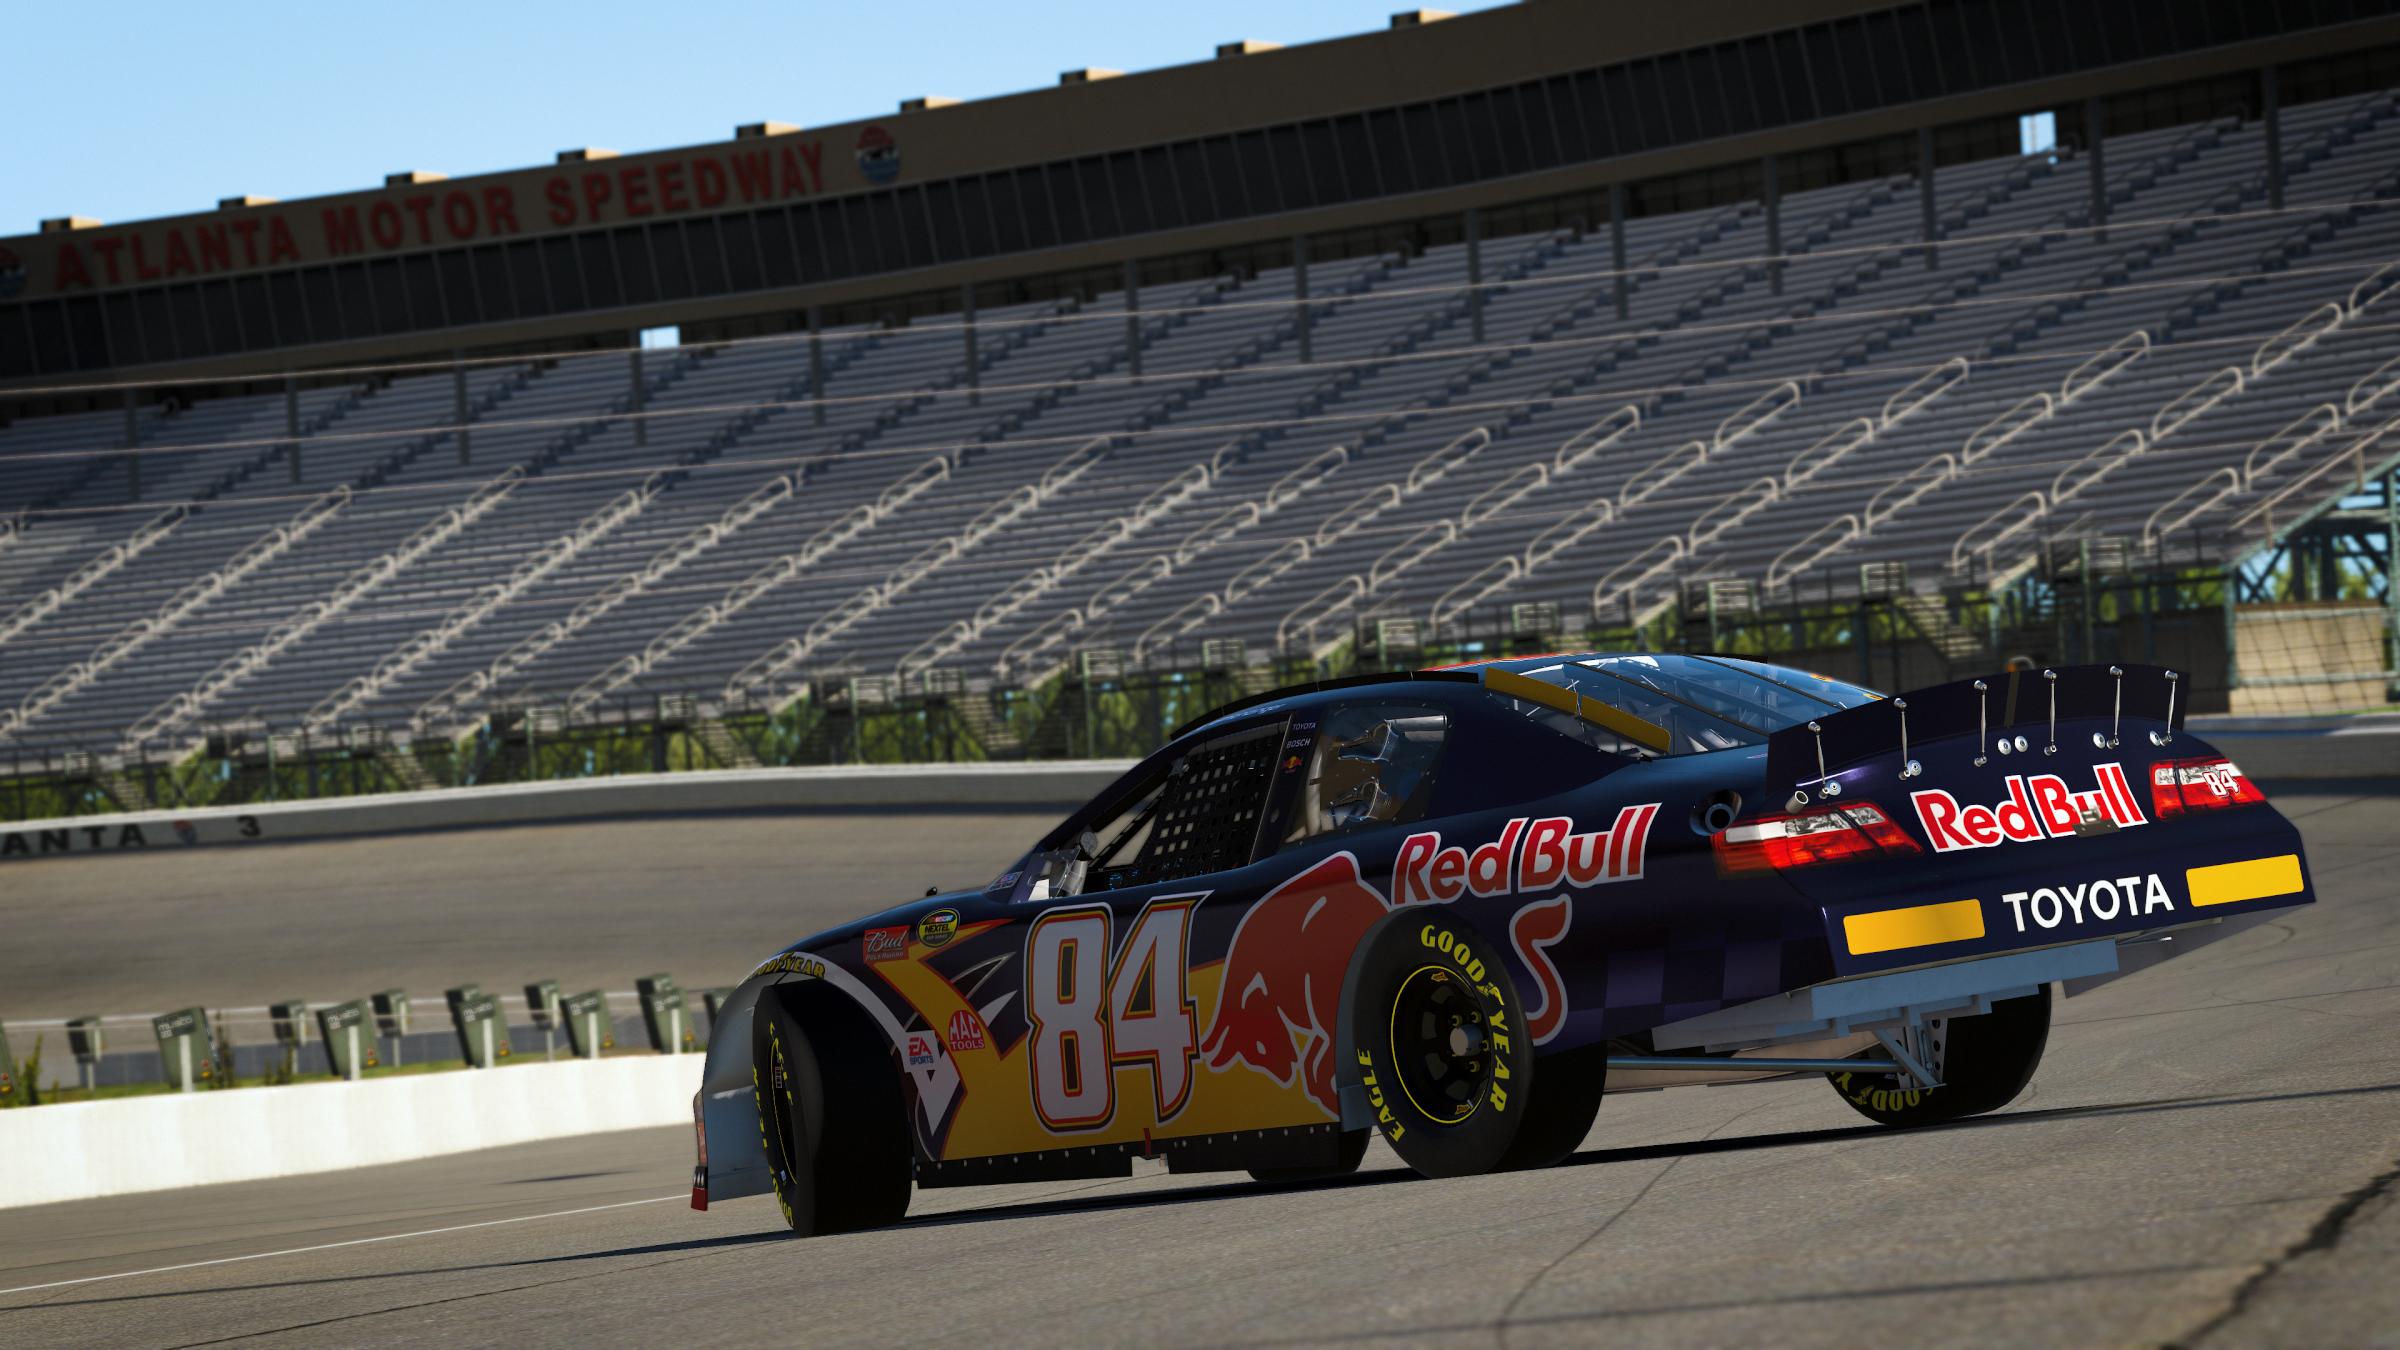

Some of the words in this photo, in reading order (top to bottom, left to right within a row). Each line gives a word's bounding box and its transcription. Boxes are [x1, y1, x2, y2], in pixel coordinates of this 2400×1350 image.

[55, 214, 301, 290] ATLANTA
[322, 186, 521, 257] MOTOR
[544, 141, 824, 226] SPEEDWAY
[1286, 737, 1312, 749] BOSCH
[1292, 721, 1317, 730] TOYOTA
[2202, 769, 2240, 798] 84
[1910, 774, 2046, 853] Red
[1, 823, 147, 855] ANTA
[237, 814, 261, 837] 3
[1391, 817, 1530, 907] Red
[1517, 801, 1663, 893] Bull
[2002, 873, 2175, 933] TOYOTA
[868, 930, 908, 952] Bud
[949, 1010, 982, 1041] MAC
[1023, 889, 1216, 1135] 84
[1420, 924, 1512, 1113] GOODYEAR
[909, 1037, 932, 1057] EA
[910, 1056, 934, 1065] SPORTS
[951, 1037, 985, 1050] TOOLS
[1356, 1047, 1406, 1143] EAGLE
